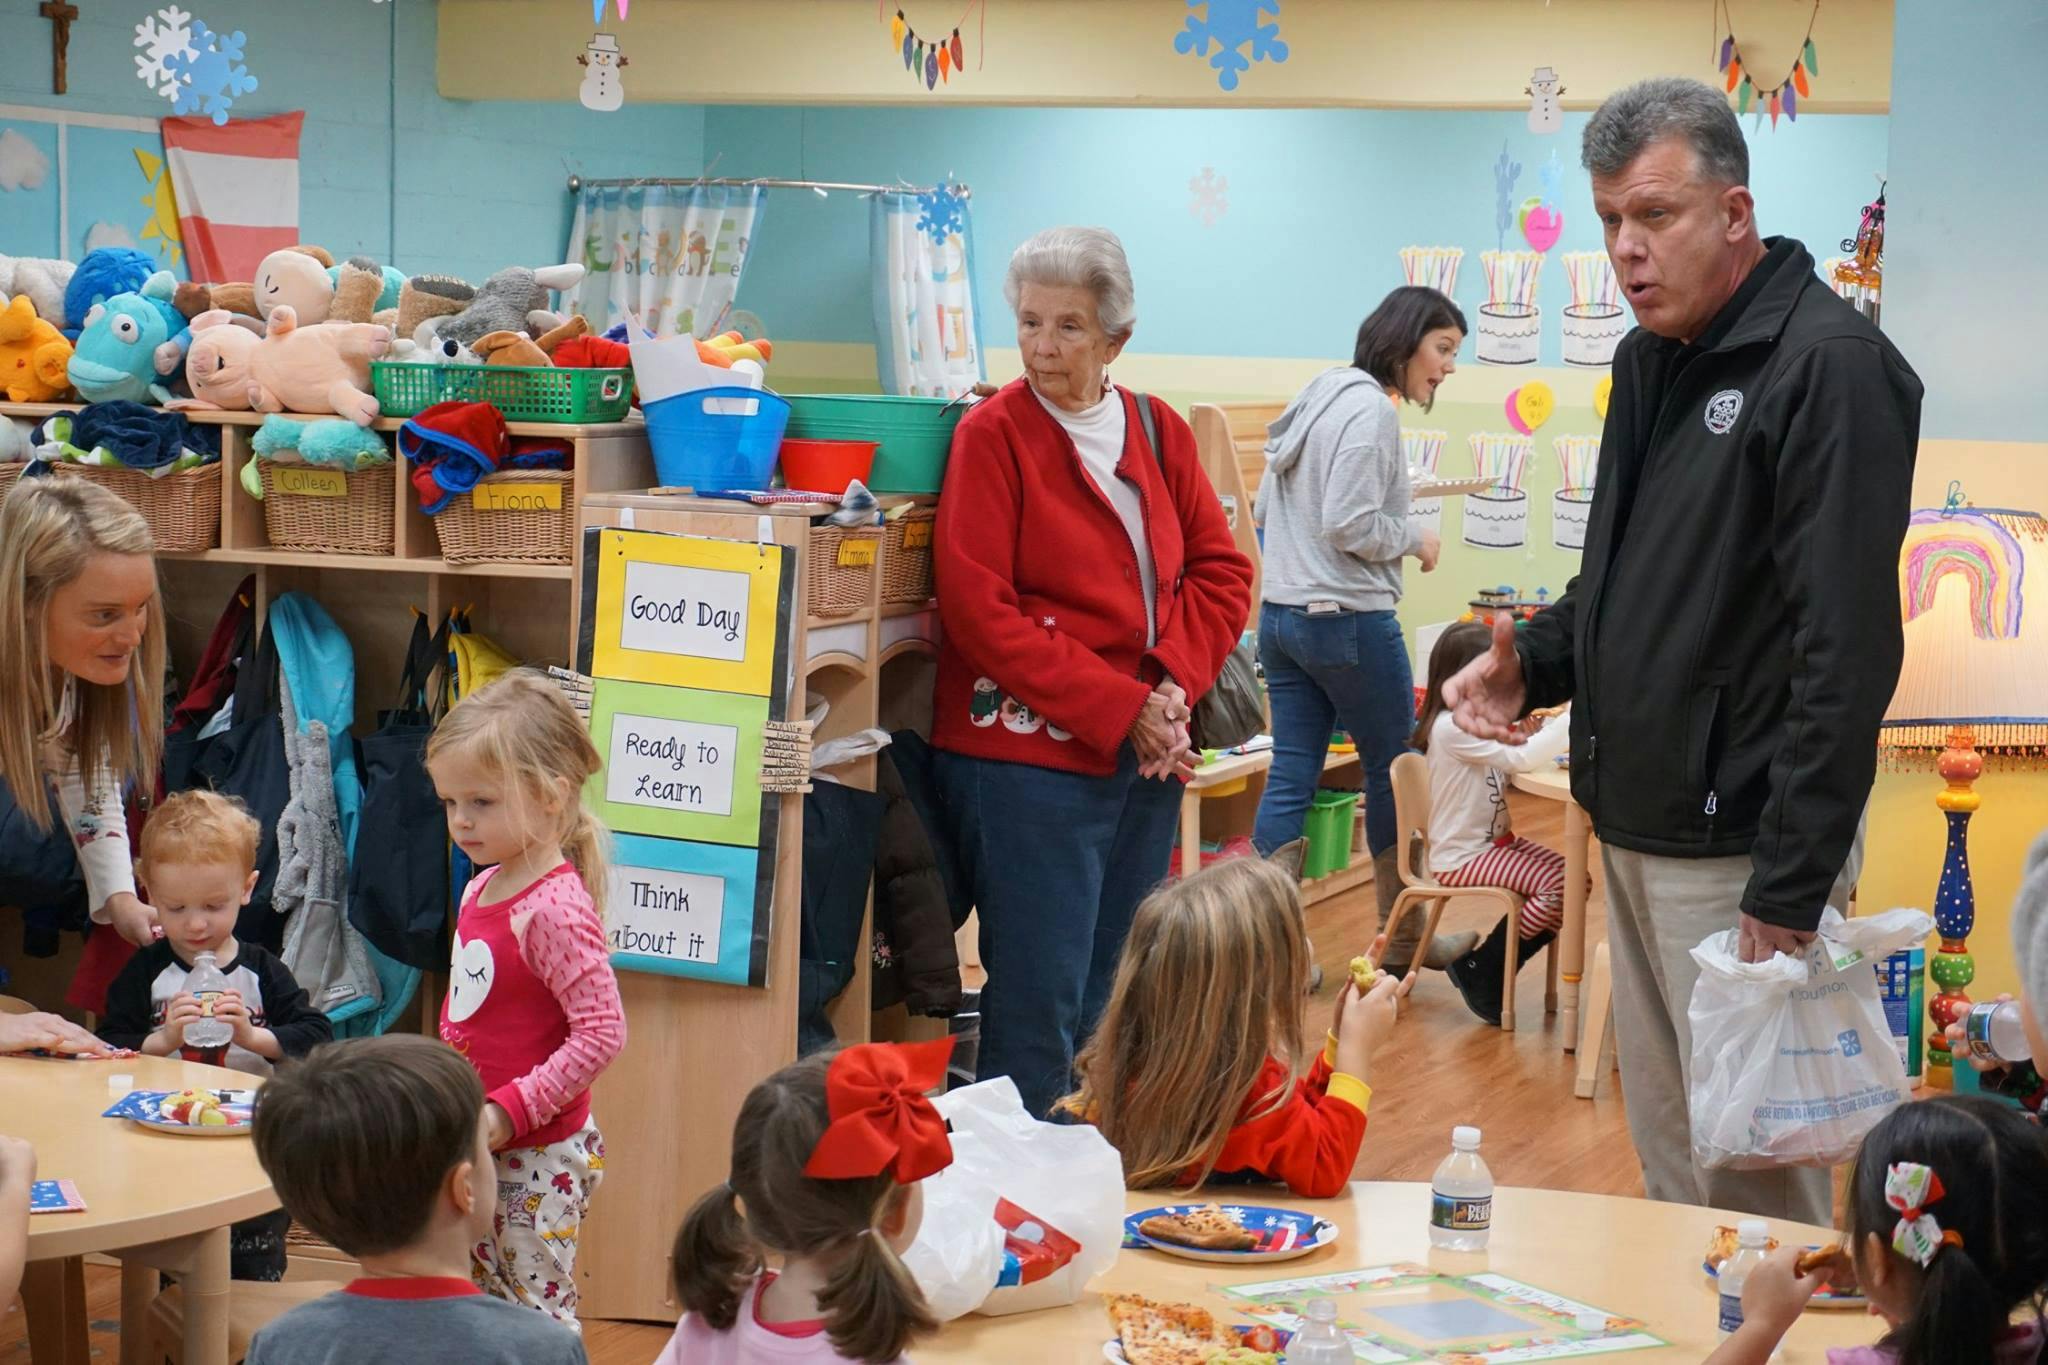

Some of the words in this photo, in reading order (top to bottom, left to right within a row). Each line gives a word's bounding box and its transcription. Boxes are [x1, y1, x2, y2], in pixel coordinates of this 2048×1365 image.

[281, 471, 338, 493] Colleen
[486, 484, 547, 511] Fiona
[631, 595, 686, 624] Good
[696, 601, 741, 642] Day
[625, 732, 687, 771] Ready
[697, 741, 719, 765] to
[634, 774, 702, 805] Learn
[629, 881, 691, 912] Think
[607, 924, 677, 955] about
[688, 932, 705, 958] it
